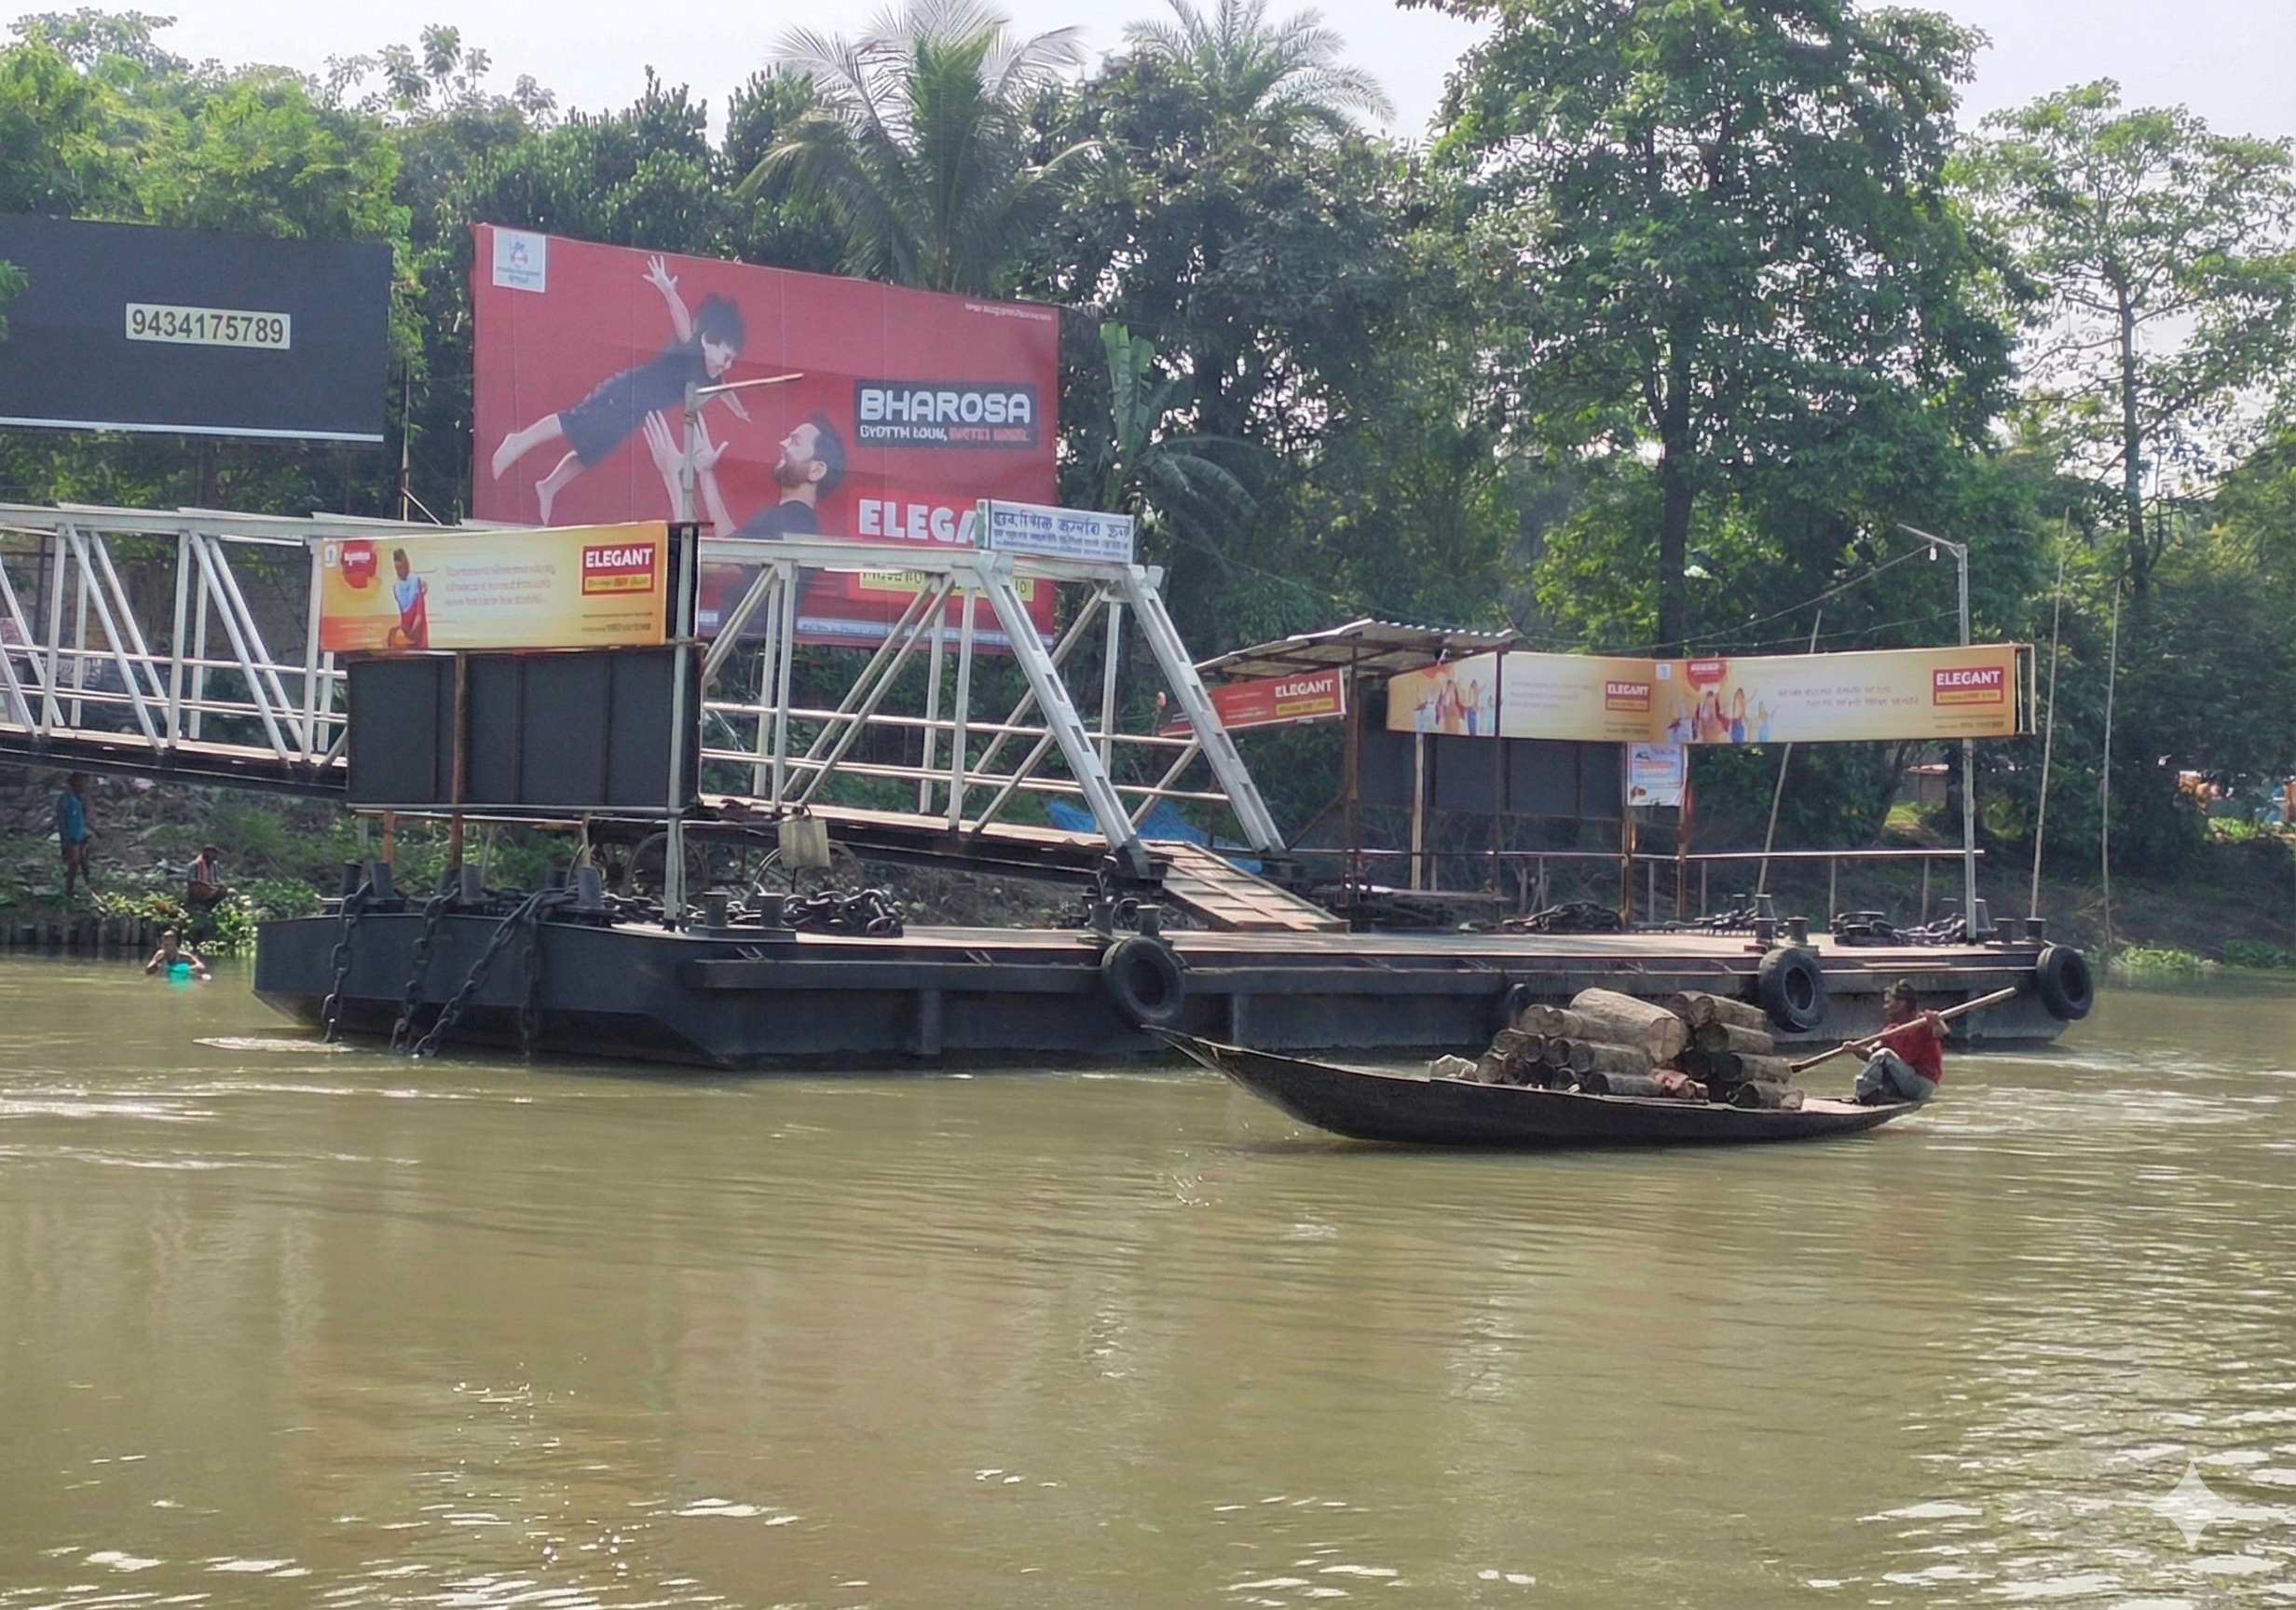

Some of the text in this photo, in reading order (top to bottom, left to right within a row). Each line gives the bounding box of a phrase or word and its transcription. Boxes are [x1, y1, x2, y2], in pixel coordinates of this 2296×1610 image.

[131, 309, 283, 344] 9434175789
[860, 389, 1031, 423] BHAROSA
[859, 498, 976, 544] ELEGA
[585, 548, 652, 568] ELEGANT
[1276, 679, 1333, 697] ELEGANT
[1936, 671, 2001, 686] ELEGANT
